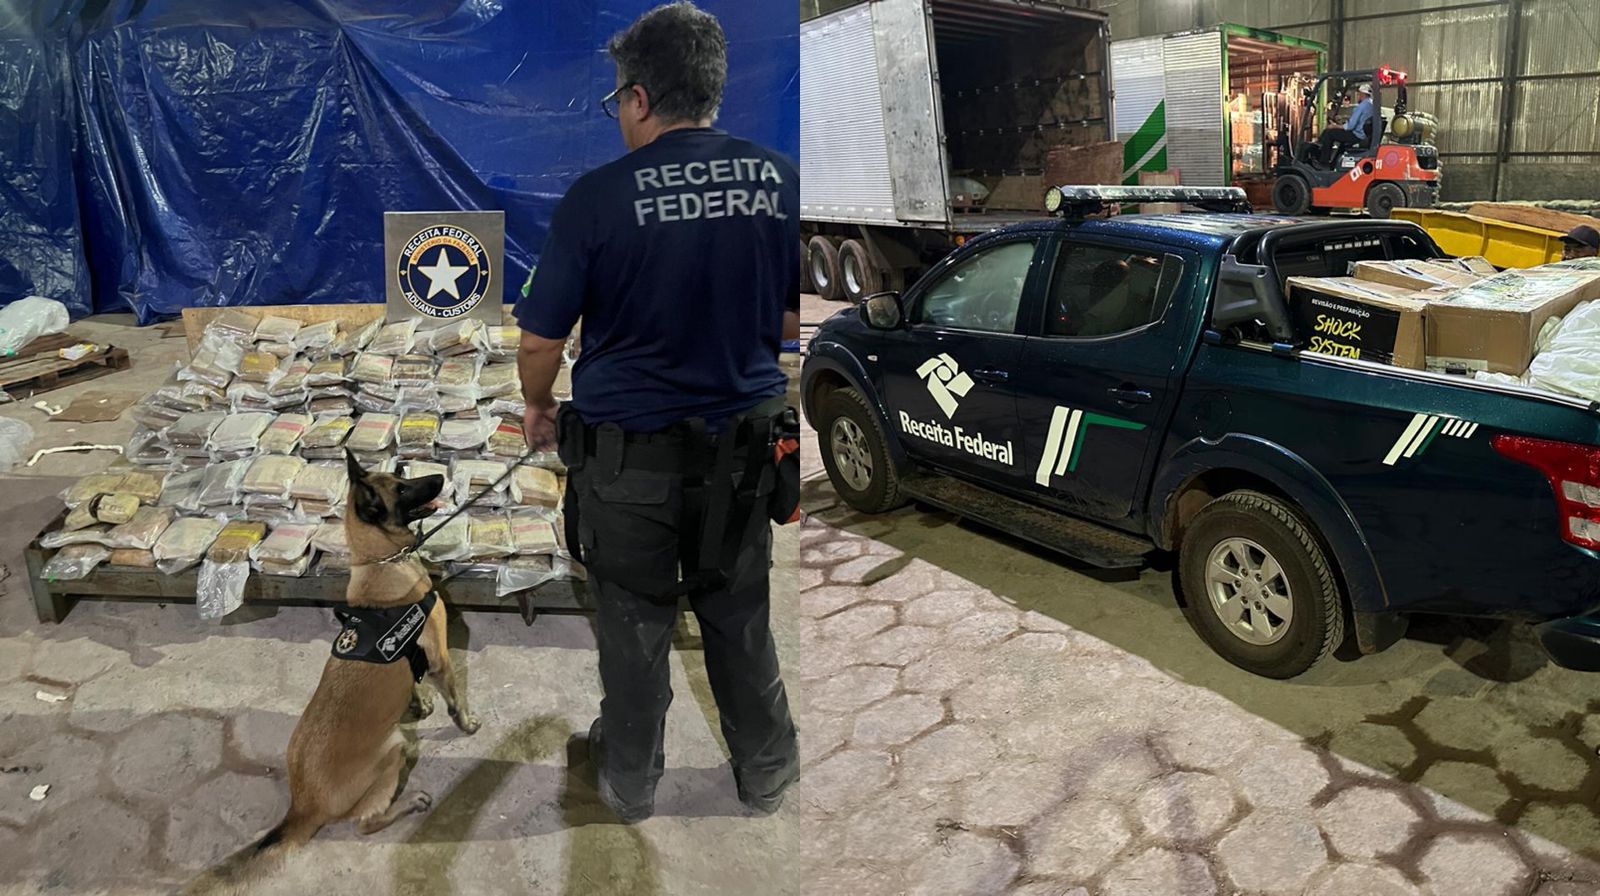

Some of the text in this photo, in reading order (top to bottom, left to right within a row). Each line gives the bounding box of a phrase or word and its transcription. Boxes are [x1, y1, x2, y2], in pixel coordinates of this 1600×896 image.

[634, 158, 783, 192] RECEITA
[634, 189, 789, 227] FEDERAL
[404, 227, 483, 258] RECEITA FEDERAL
[405, 291, 436, 316] ADUANA
[442, 292, 481, 317] CUSTOMS
[1314, 314, 1362, 341] SHOCK
[1308, 335, 1361, 360] SYSTEM
[899, 410, 1013, 465] Receita Federal
